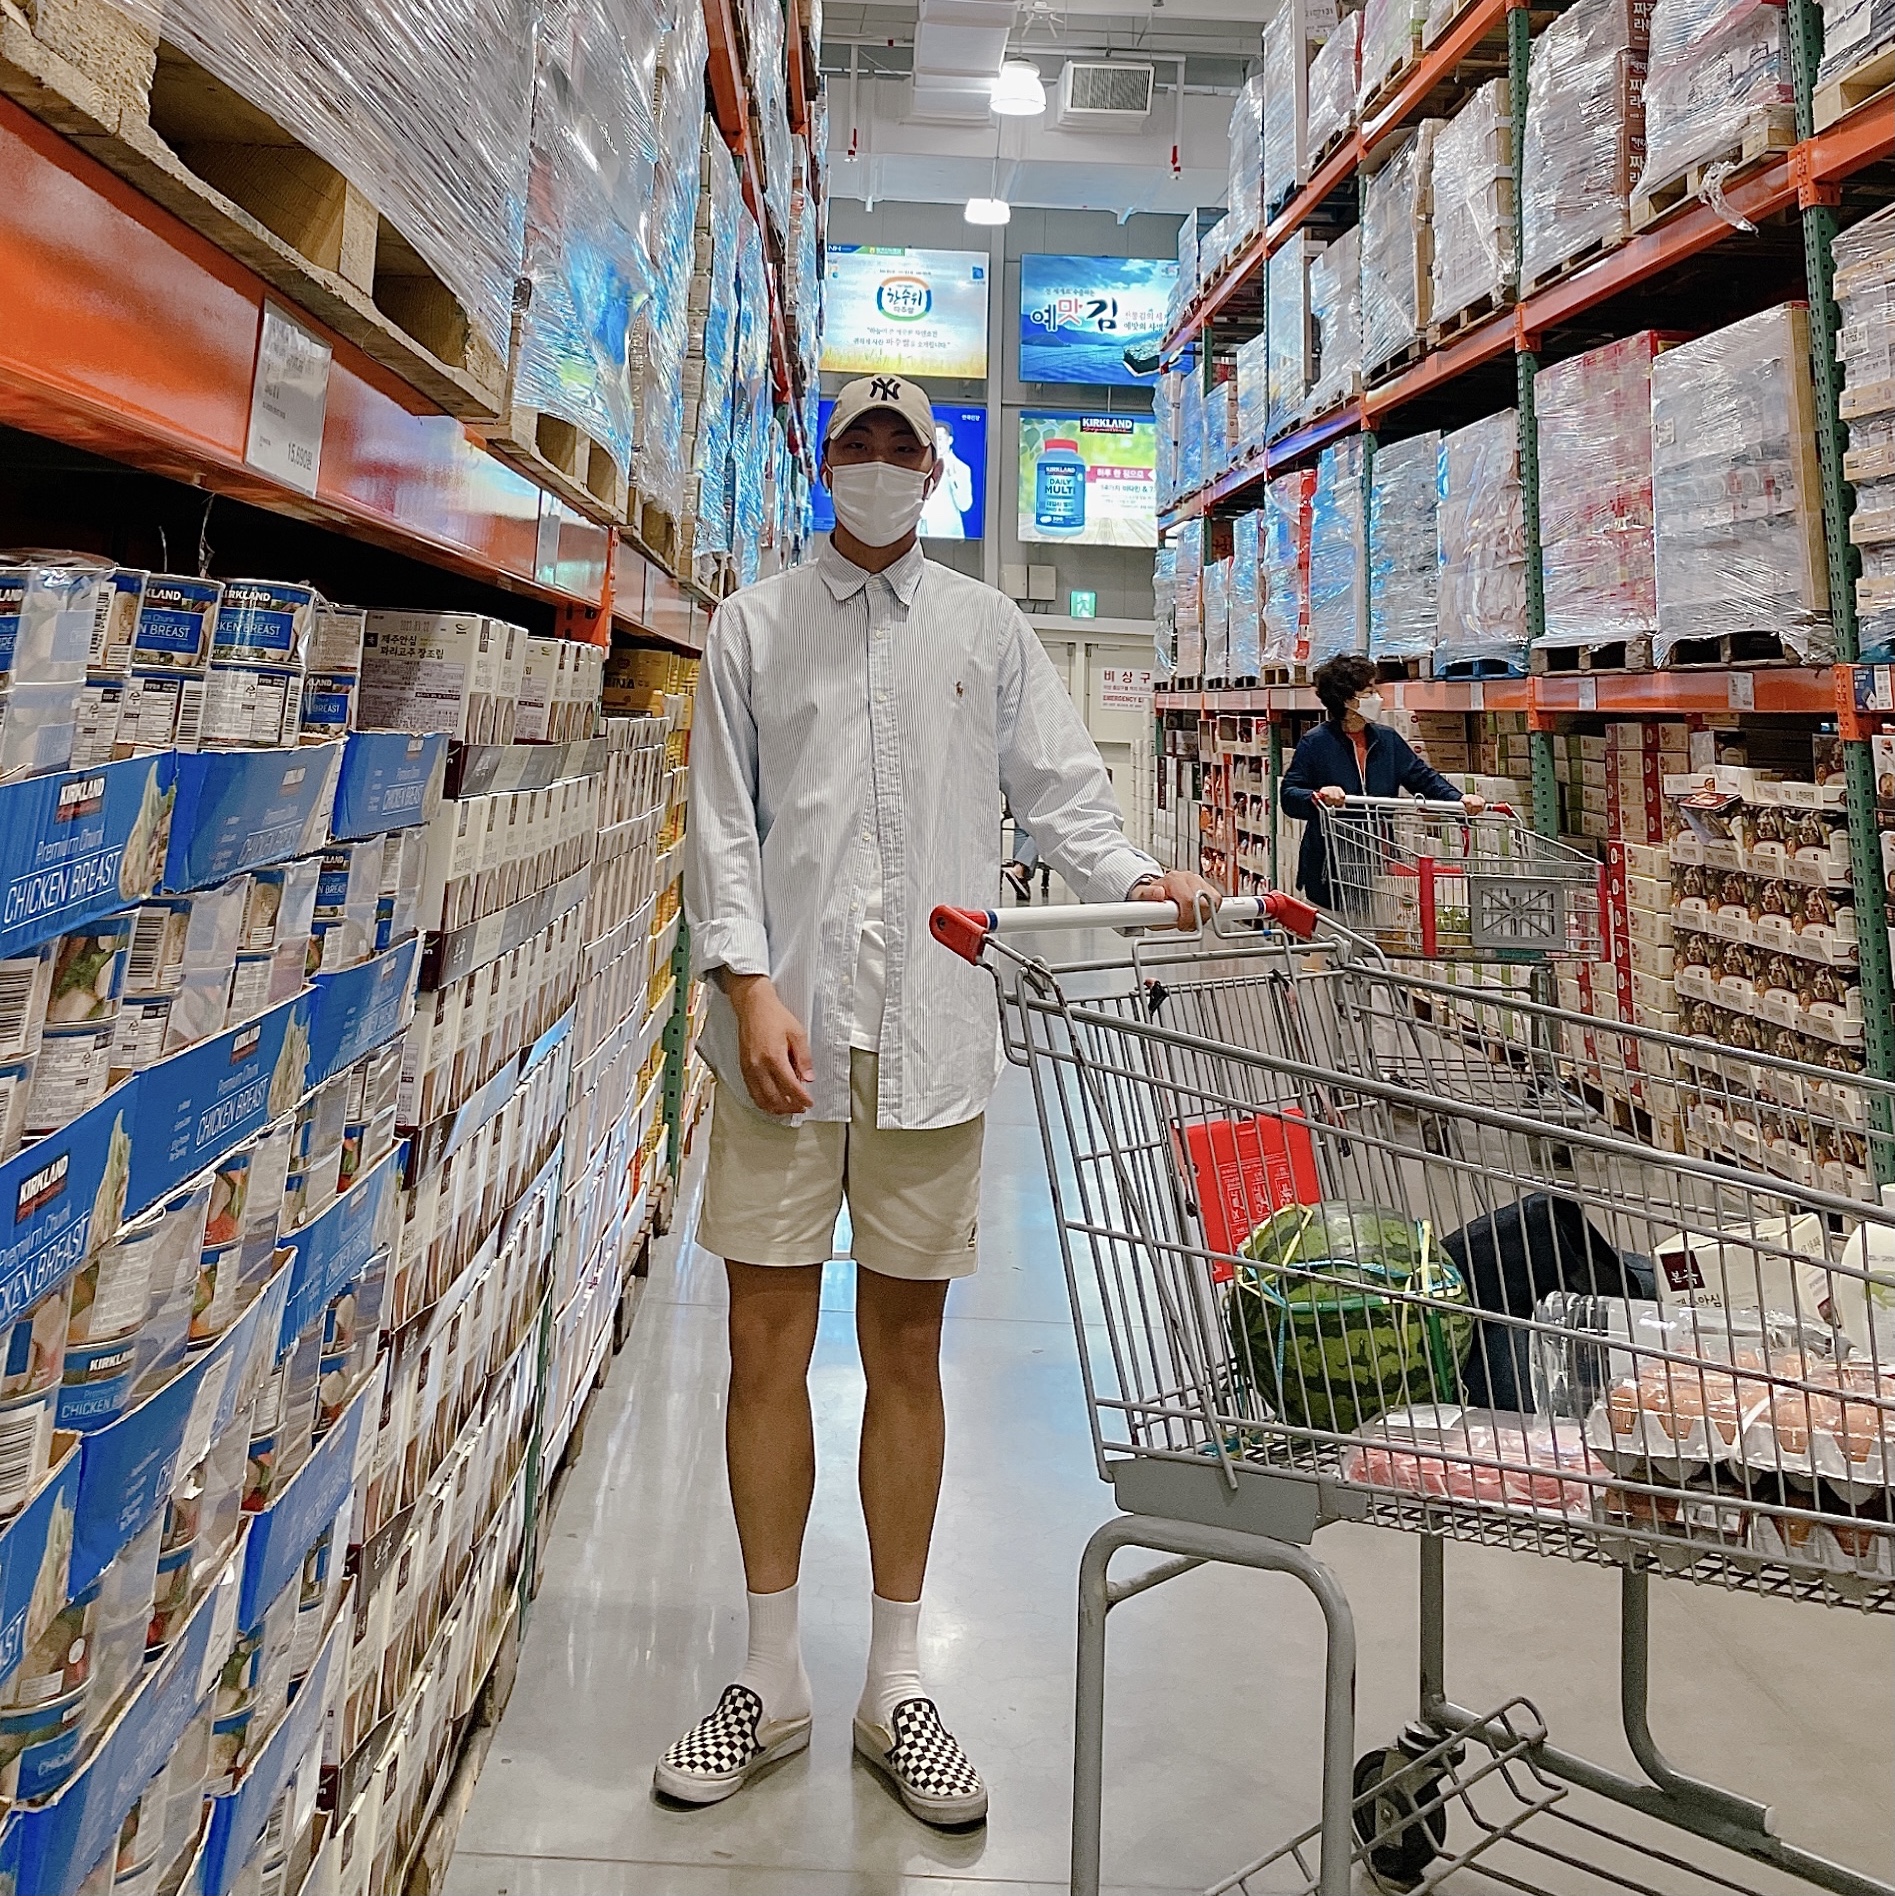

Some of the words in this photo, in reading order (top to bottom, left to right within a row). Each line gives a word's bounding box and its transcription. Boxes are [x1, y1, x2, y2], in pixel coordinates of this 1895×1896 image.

[886, 288, 923, 307] 한수위
[869, 377, 902, 401] NY
[1082, 417, 1133, 429] KIRKLAND
[1045, 466, 1076, 474] KIRKLAND
[1045, 486, 1076, 495] MULTI
[1049, 478, 1072, 486] DAILY
[0, 588, 24, 602] LAND
[222, 587, 272, 602] IRKLAND
[150, 624, 191, 639] BREAST
[1104, 670, 1151, 684] 비상구
[59, 777, 106, 807] KIRKLAND
[4, 866, 71, 925] CHICKEN
[70, 850, 123, 900] BREAST
[194, 1099, 235, 1147] CHICKEN
[233, 1077, 270, 1121] BREAST
[18, 1155, 69, 1207] KIRKLAND
[34, 1215, 91, 1291] BREAST
[61, 1399, 109, 1419] CHICKEN
